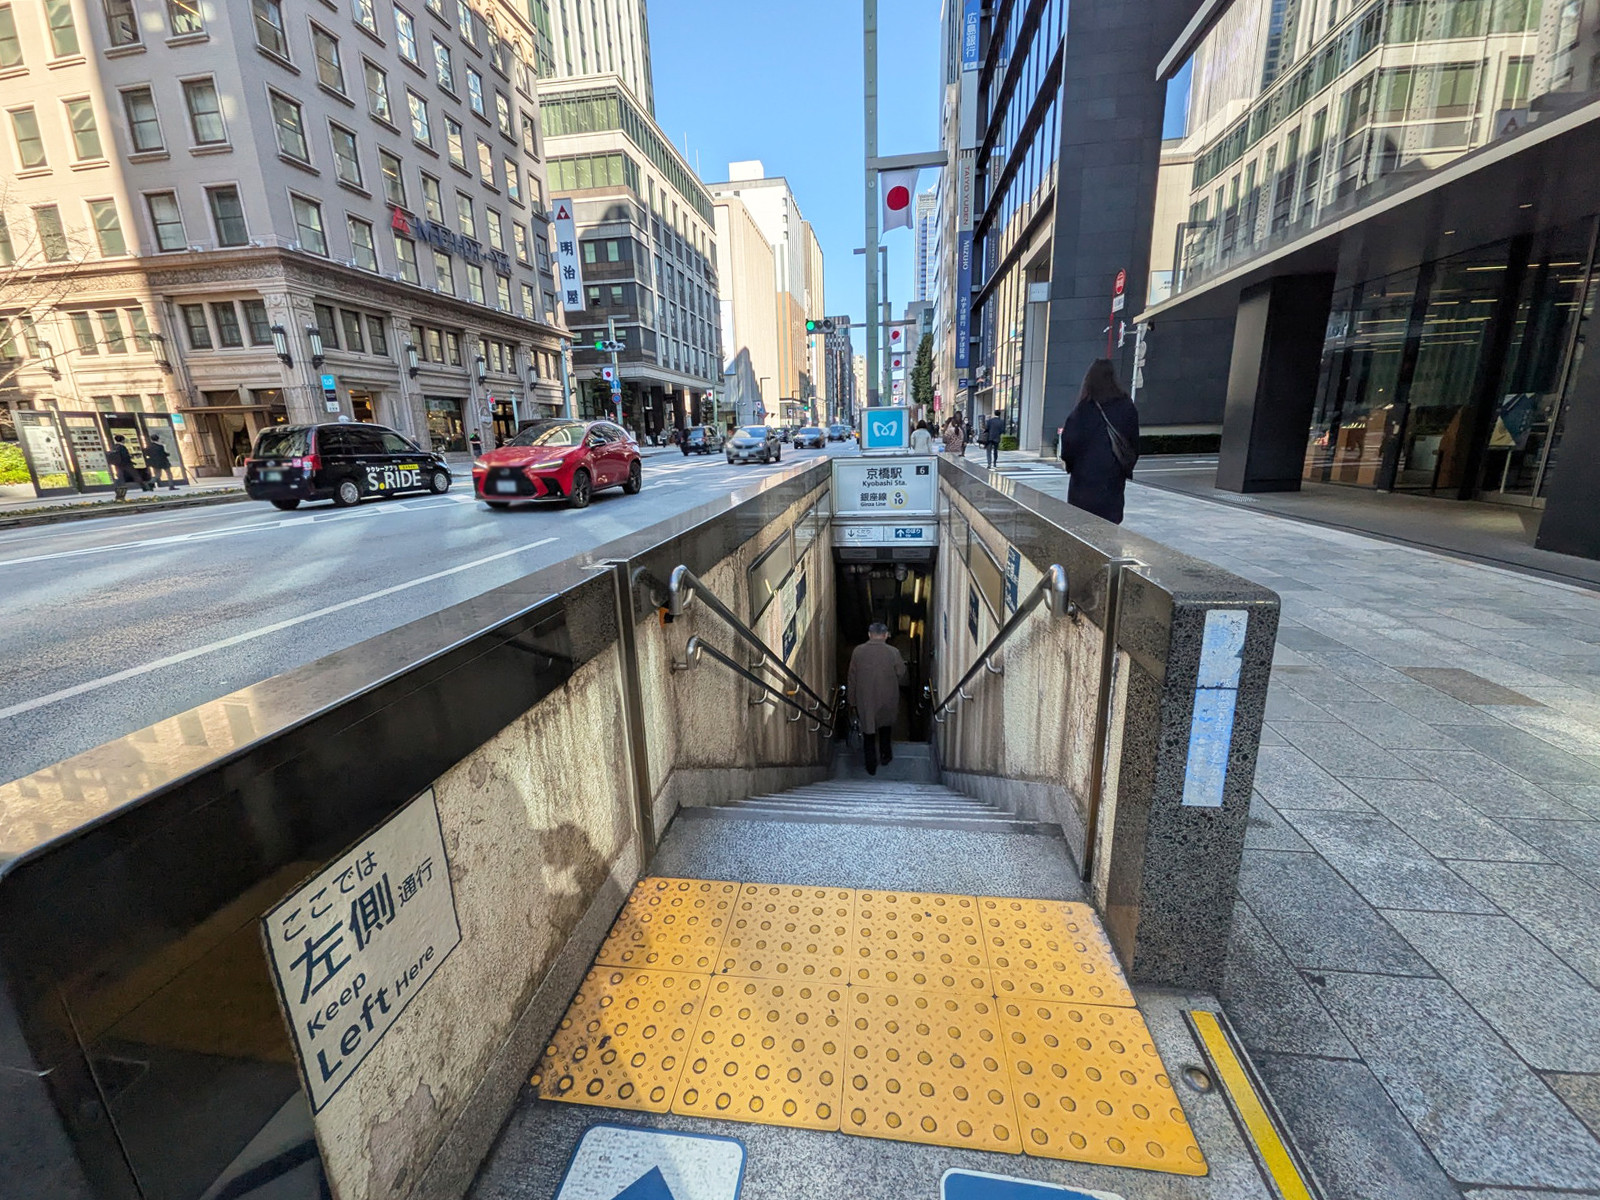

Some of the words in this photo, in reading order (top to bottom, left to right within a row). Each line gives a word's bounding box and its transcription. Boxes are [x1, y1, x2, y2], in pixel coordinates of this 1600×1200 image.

[560, 241, 579, 305] 明治屋
[367, 469, 422, 491] S.RIDE
[862, 480, 893, 488] Kyobashi
[866, 467, 902, 479] 京橋駅
[860, 492, 887, 502] 銀座線
[283, 851, 378, 942] ここでは
[306, 972, 367, 1040] Keep
[316, 987, 391, 1084] Left
[395, 946, 435, 998] Here
